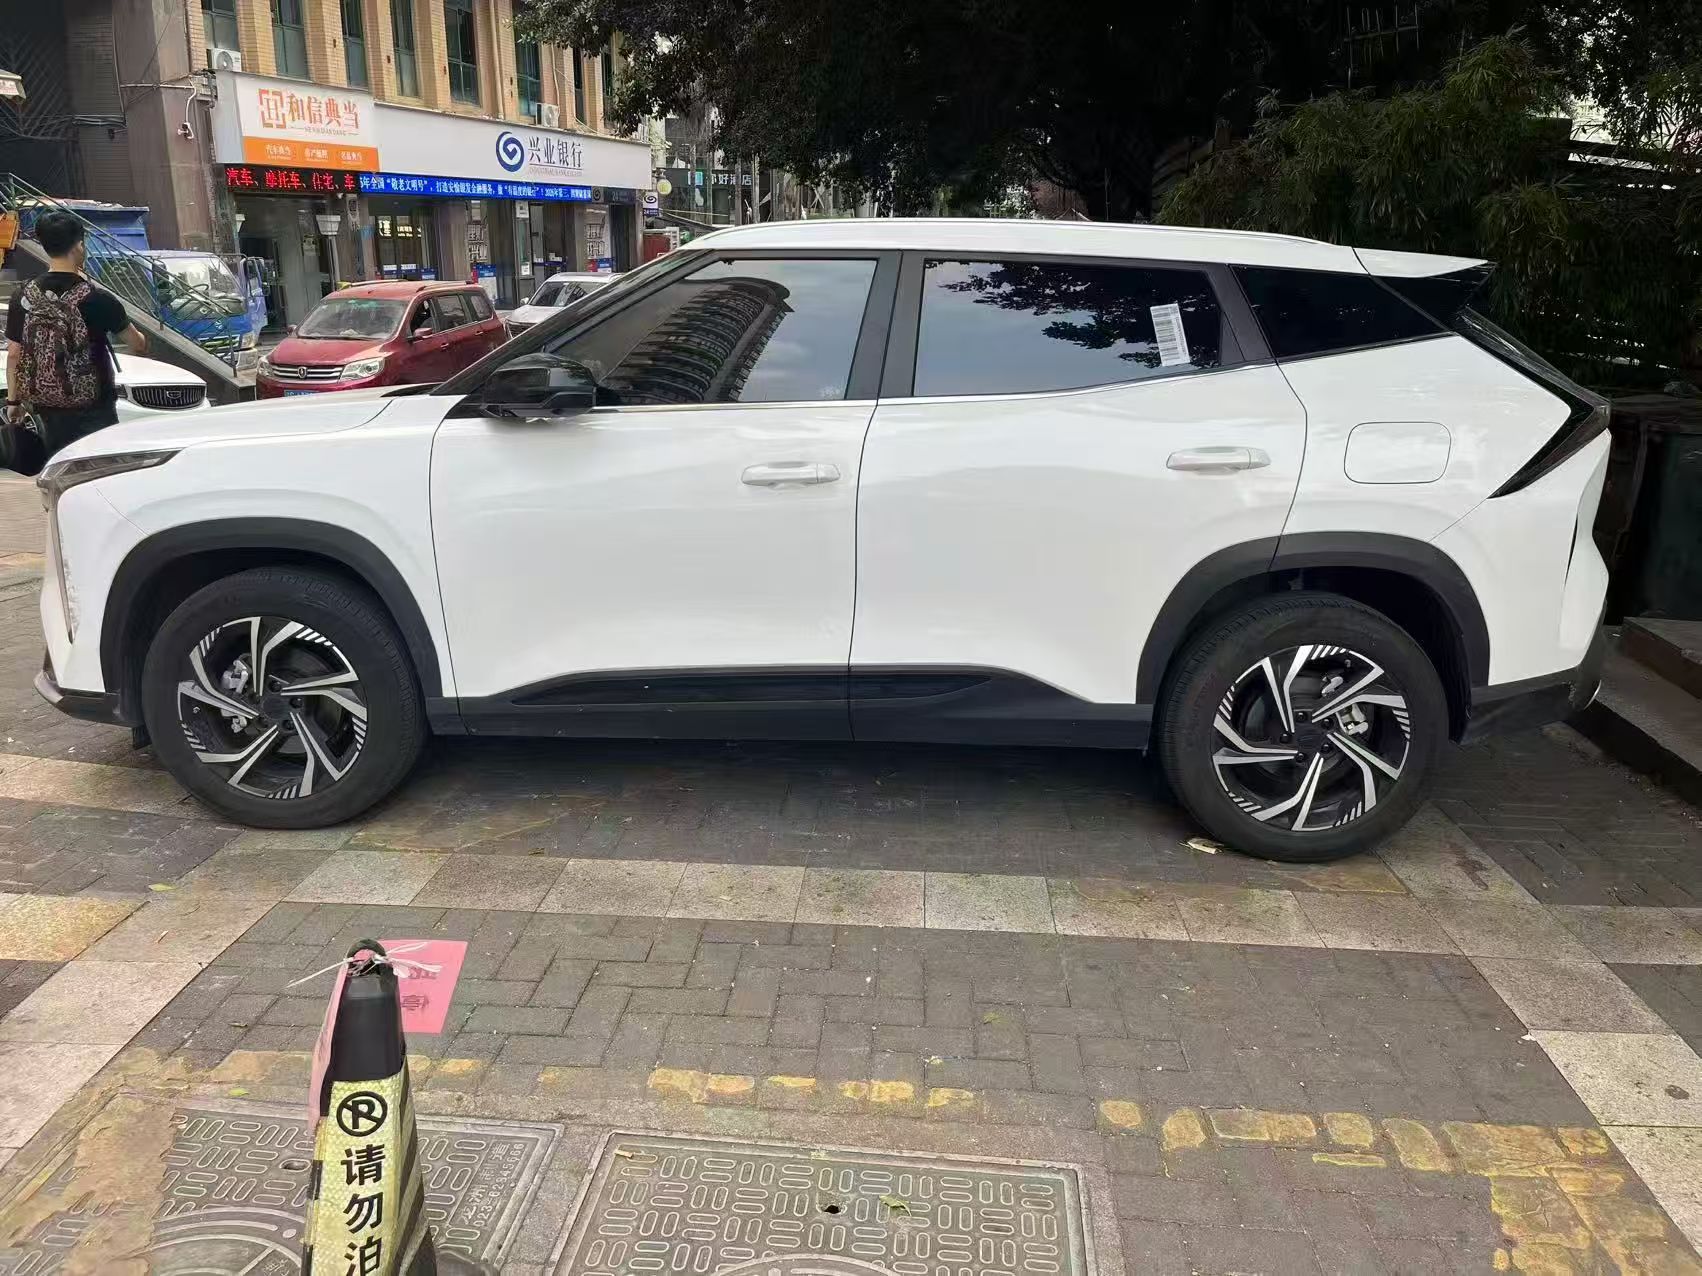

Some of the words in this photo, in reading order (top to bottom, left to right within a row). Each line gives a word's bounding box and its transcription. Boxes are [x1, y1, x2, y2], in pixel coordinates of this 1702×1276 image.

[287, 92, 359, 129] 和信典当
[527, 136, 582, 168] 兴业银行
